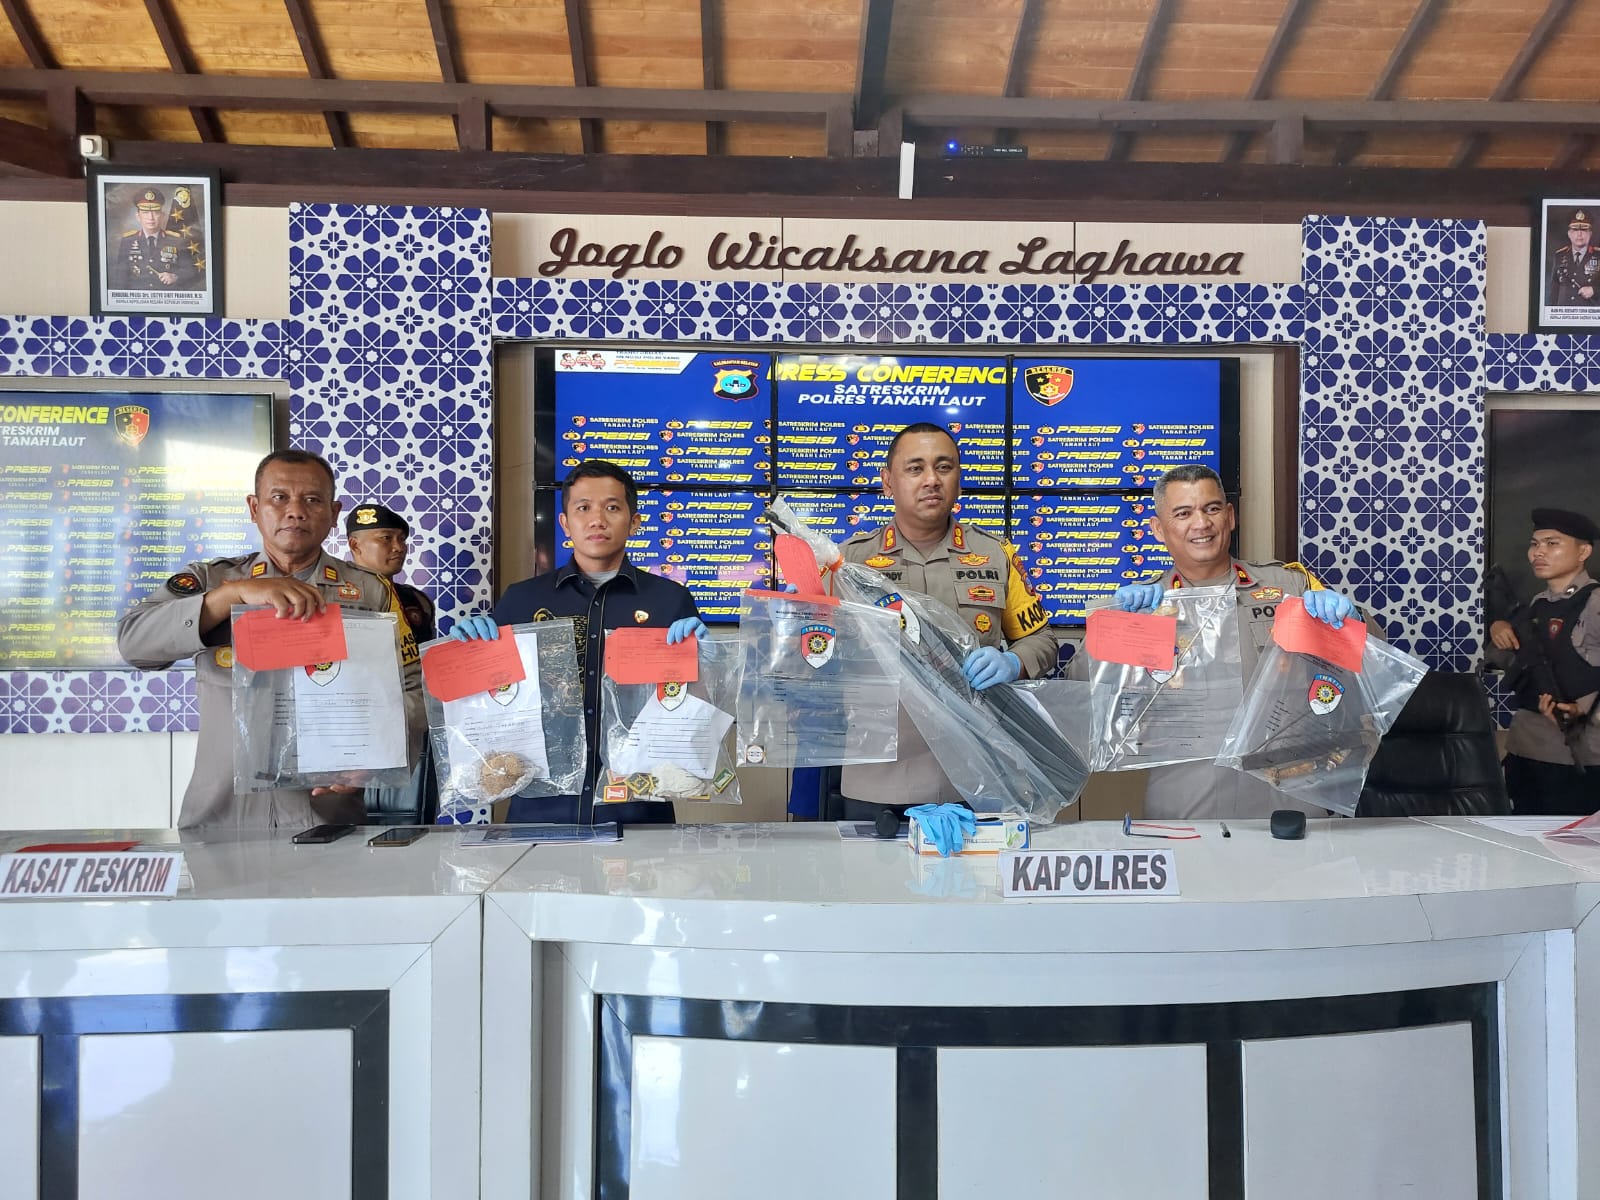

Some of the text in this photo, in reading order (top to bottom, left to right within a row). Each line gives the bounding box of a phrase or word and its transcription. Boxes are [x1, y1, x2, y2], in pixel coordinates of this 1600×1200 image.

[538, 227, 1244, 284] Joglo Wicaksana Laghawa
[767, 363, 1018, 384] PRESS CONFERENCE
[833, 384, 950, 396] SATRESKRIM
[798, 394, 986, 407] POLRES TANAH LAUT
[686, 421, 753, 429] PRESISI
[1056, 426, 1121, 434] PRESISI
[583, 432, 651, 440] PRESISI
[3, 436, 86, 447] TANAH LAUT
[1141, 439, 1207, 447] PRESISI
[686, 447, 753, 455] PRESISI
[1056, 452, 1121, 460] PRESISI
[583, 458, 651, 466] ESISI
[686, 473, 753, 482] PRESISI
[1056, 477, 1121, 486] PRESISI
[686, 502, 753, 510] PRESISI
[1055, 506, 1120, 514] PRESISI
[799, 517, 838, 525] ESISI
[686, 528, 753, 536] PRESISI
[1055, 531, 1120, 539] PRESISI
[686, 554, 753, 562] PRESISI
[1055, 557, 1120, 565] PRESISI
[881, 571, 903, 581] DDY
[956, 571, 999, 581] POLRI
[686, 580, 753, 588] PRESISI
[1055, 582, 1120, 591] PRESISI
[696, 606, 752, 614] RESISI
[401, 633, 415, 648] AS
[1, 857, 173, 893] KASAT RESKRIM
[1012, 854, 1167, 891] KAPOLRES
